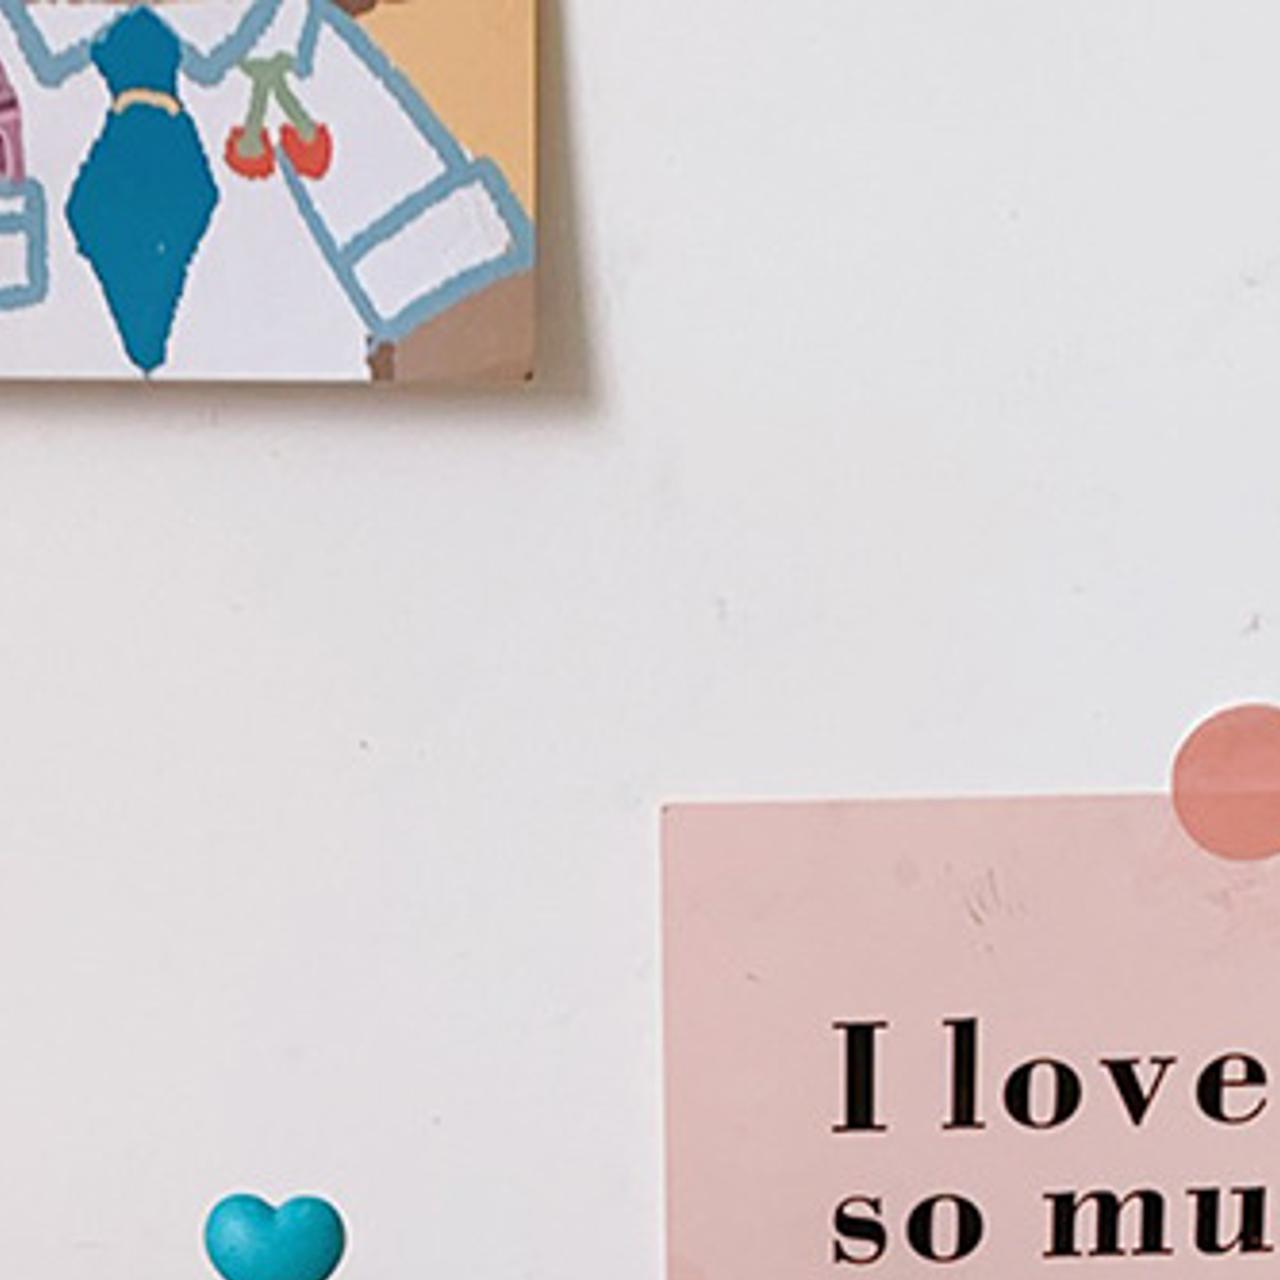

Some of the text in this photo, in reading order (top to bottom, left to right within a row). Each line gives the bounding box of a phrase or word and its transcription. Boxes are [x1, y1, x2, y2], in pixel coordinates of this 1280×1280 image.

[832, 1020, 888, 1133] I
[941, 1016, 1268, 1131] love
[833, 1192, 984, 1265] so
